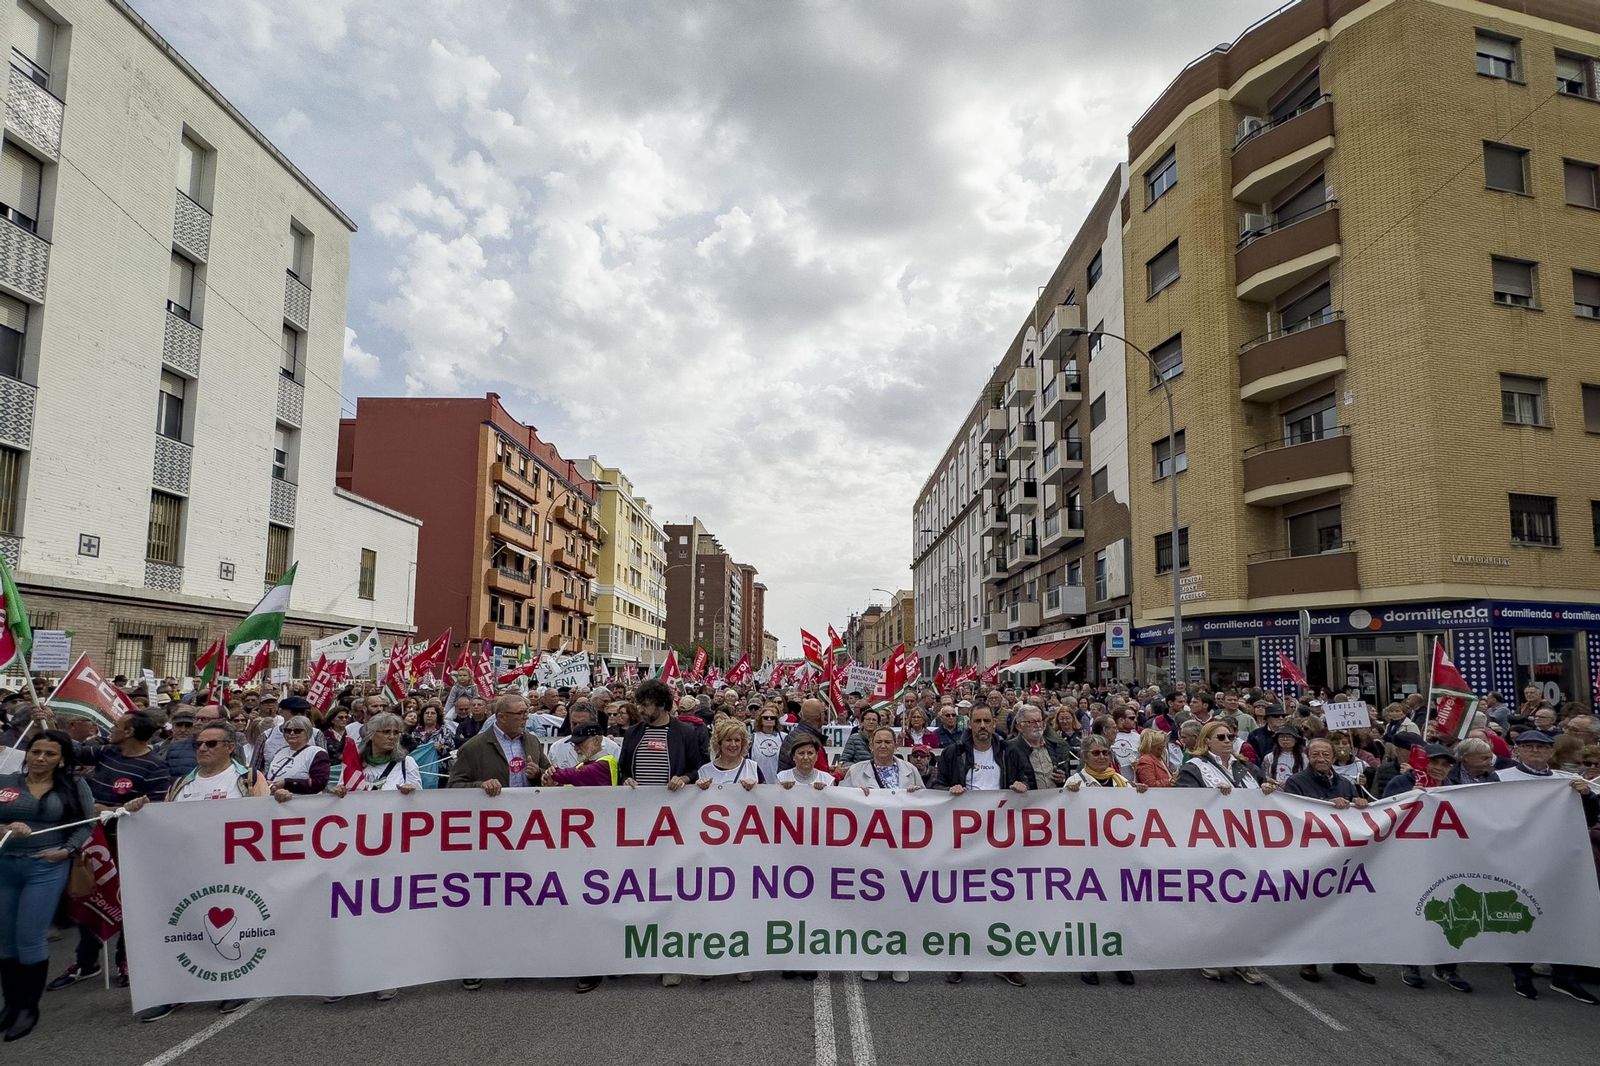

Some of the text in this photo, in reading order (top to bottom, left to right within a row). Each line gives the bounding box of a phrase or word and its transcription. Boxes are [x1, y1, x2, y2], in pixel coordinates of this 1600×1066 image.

[1383, 606, 1489, 623] dormitienda
[1501, 608, 1552, 619] dormitienda
[1562, 610, 1600, 621] dormitien
[1204, 619, 1264, 631] dormitienda
[1328, 702, 1363, 711] SEVILLA
[1335, 719, 1363, 728] LUCHA
[113, 781, 132, 789] UGT
[224, 800, 1469, 865] RECUPERAR LA SANIDAD PÚBLICA ANDALUZA
[331, 859, 1376, 919] NUESTRA SALUD NO ES VUESTRA MERCANCÍA
[1415, 873, 1544, 916] COORDINADORA ANDALUZA DE MAREAS BLANCAS
[168, 884, 271, 926] MAREA BLANCA EN SEVILLA
[1496, 911, 1523, 920] CAMB
[164, 928, 276, 943] sanidad pública
[624, 920, 1123, 960] Marea Blanca en Sevilla
[176, 947, 267, 982] NO A LOS RECORTES
